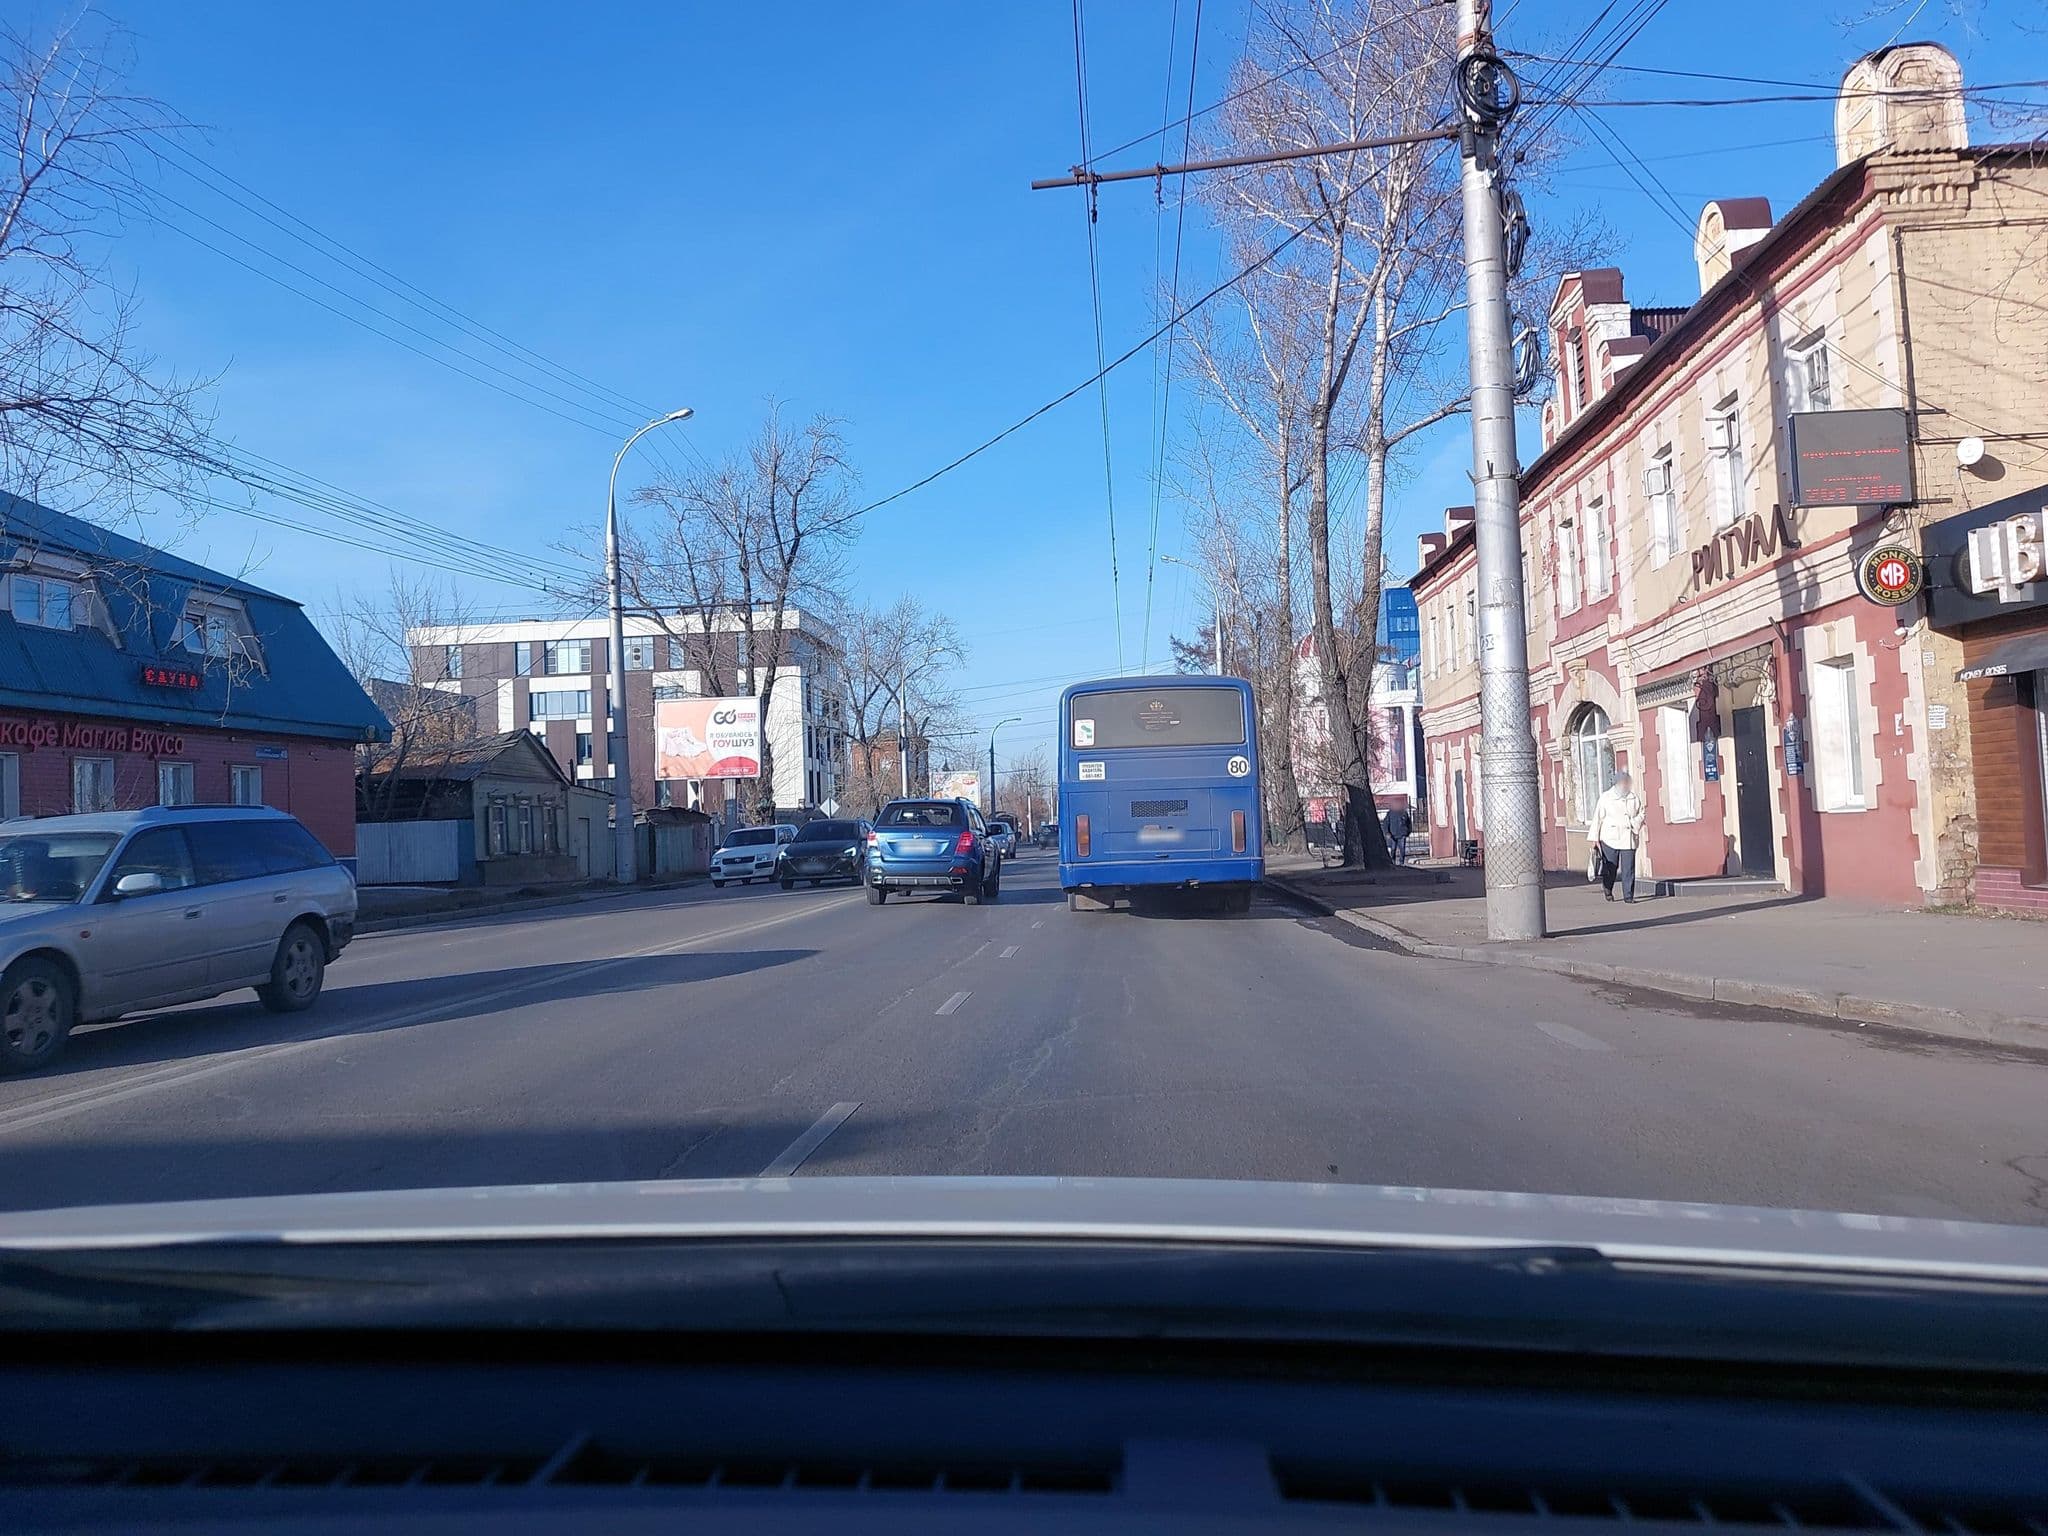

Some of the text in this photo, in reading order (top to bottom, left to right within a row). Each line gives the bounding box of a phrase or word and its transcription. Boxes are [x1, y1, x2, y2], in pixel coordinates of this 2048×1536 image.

[1691, 503, 1802, 592] РИТУАЛ
[1871, 551, 1914, 567] MONEY
[1874, 583, 1914, 599] ROSES
[1960, 669, 1983, 680] MONEY
[0, 719, 185, 759] кафе Магия Вкуса
[713, 739, 754, 748] ГОУШУЗ
[1230, 760, 1248, 774] 80
